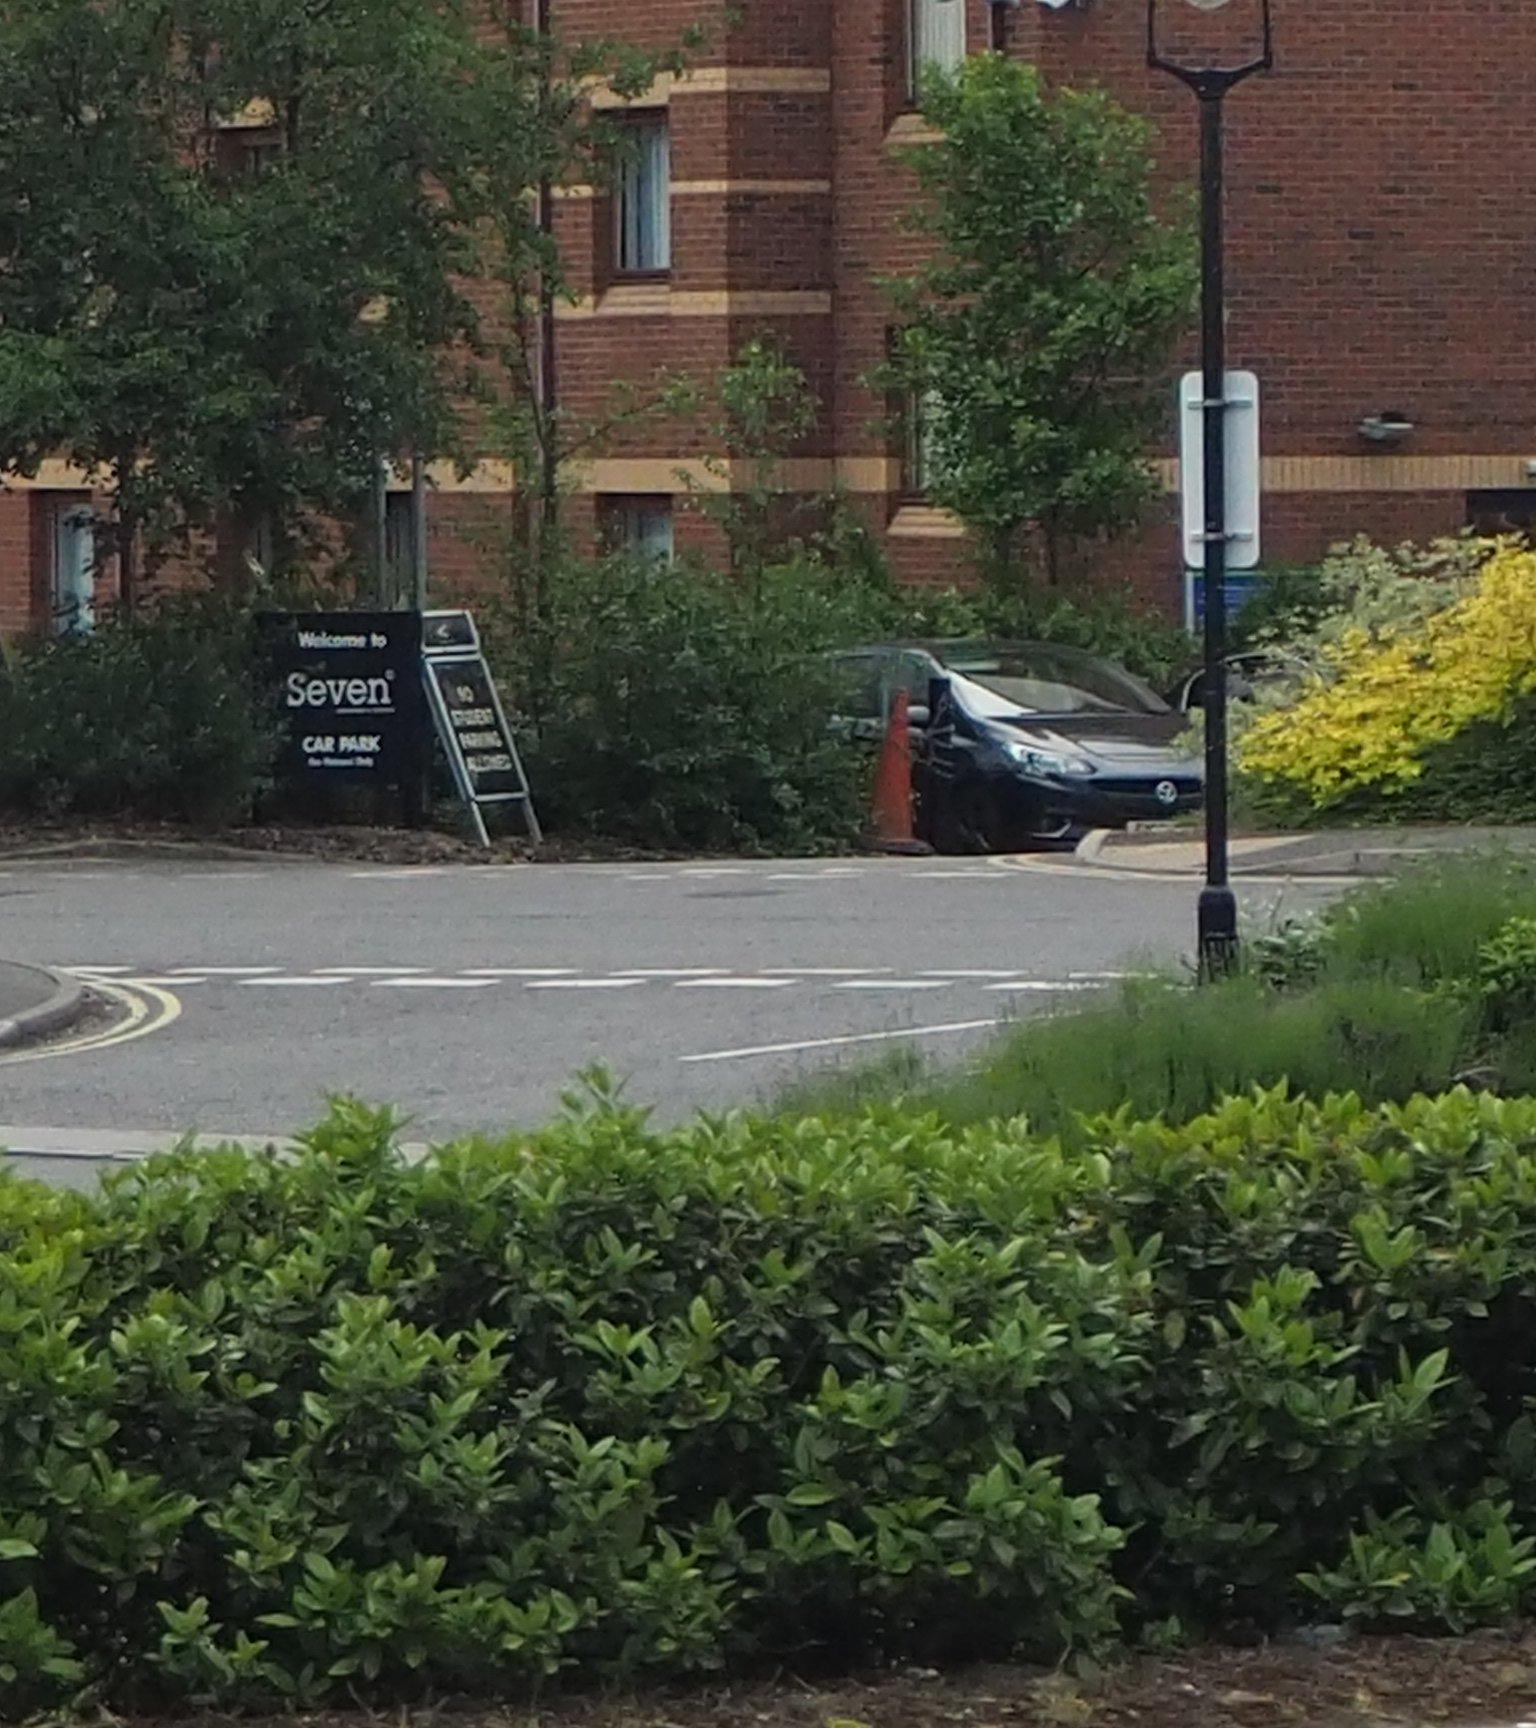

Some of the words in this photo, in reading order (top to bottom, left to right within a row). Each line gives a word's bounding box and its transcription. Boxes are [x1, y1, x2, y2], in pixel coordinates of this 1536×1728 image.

[371, 632, 387, 648] to
[302, 735, 335, 752] CAR
[338, 735, 381, 752] PARK
